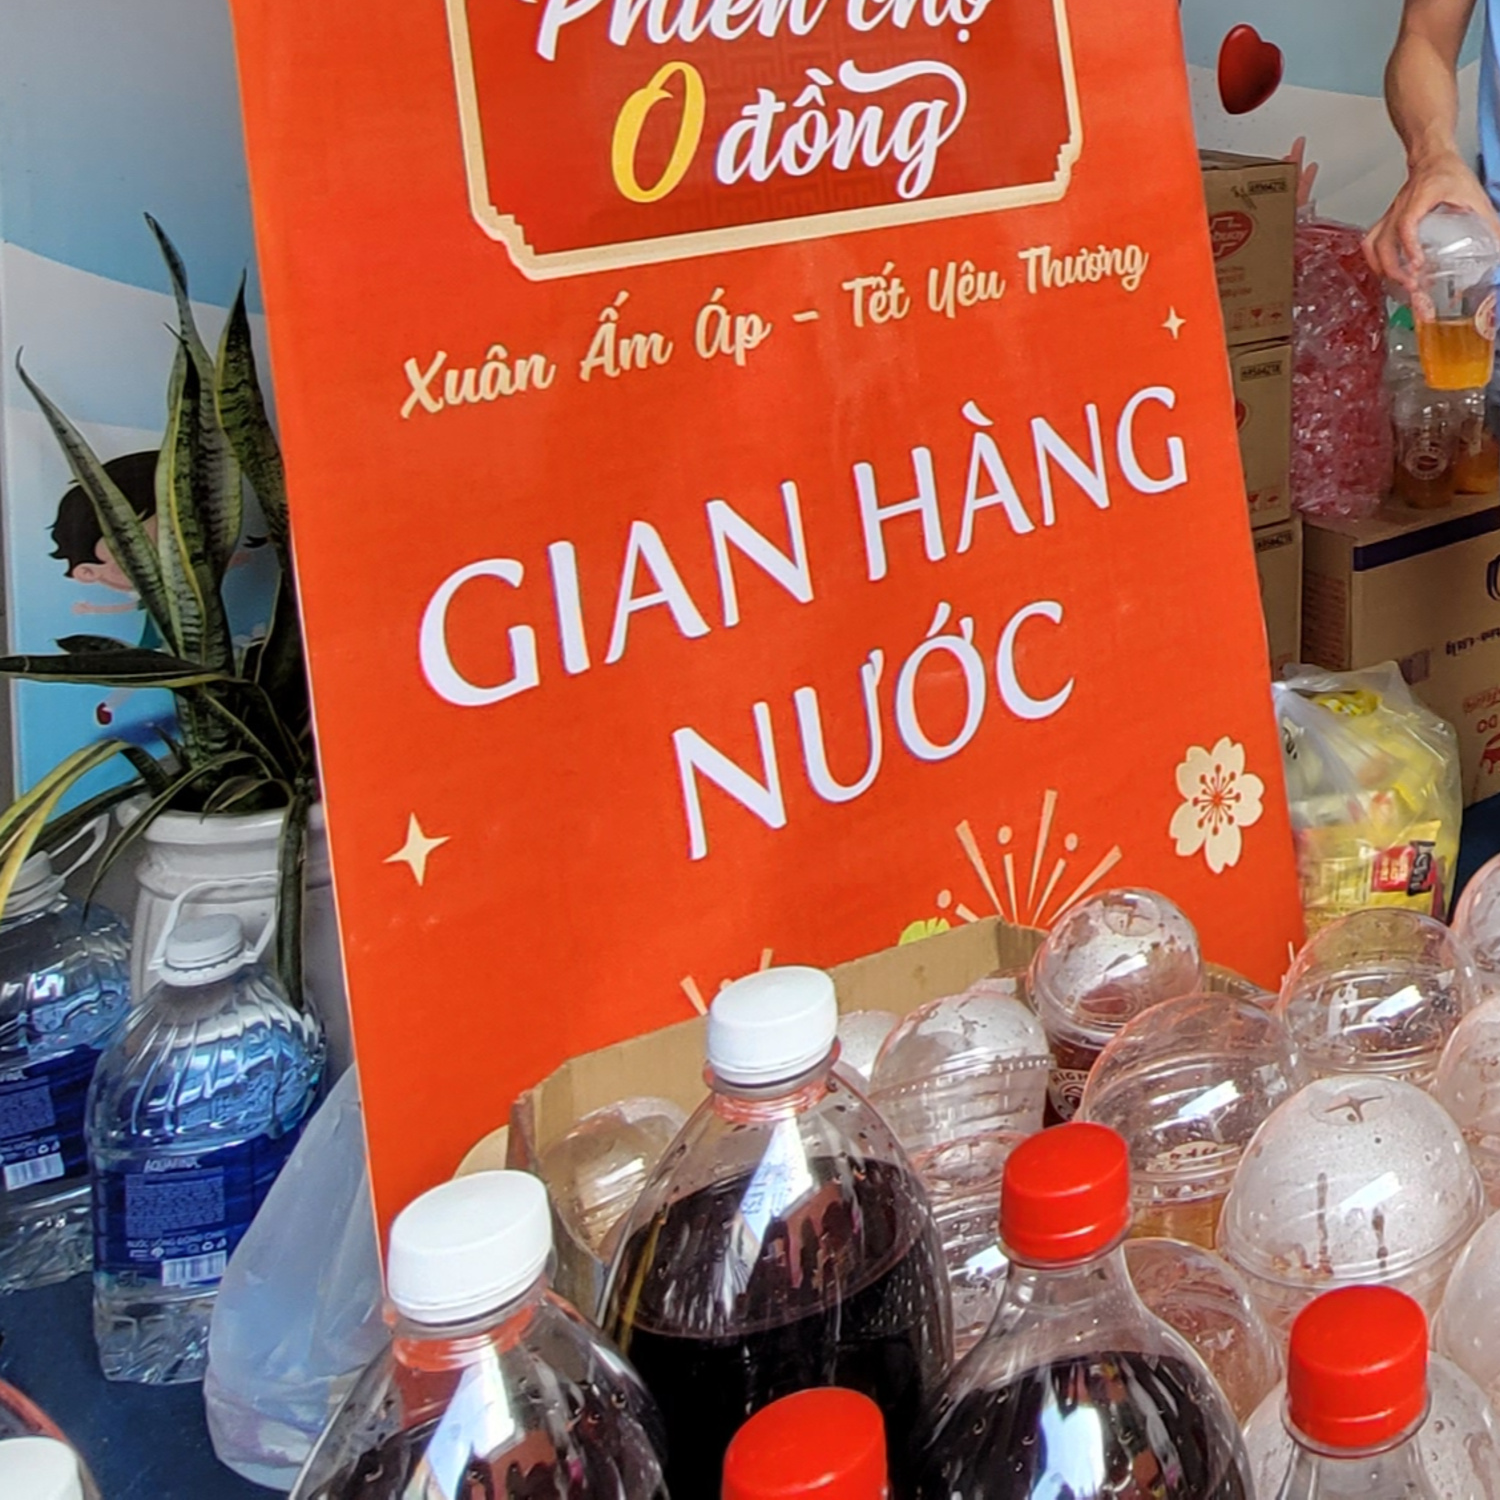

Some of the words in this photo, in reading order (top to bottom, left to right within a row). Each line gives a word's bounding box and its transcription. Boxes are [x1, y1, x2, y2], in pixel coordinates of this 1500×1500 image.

[714, 58, 967, 201] đồng
[400, 348, 557, 419] Xuân
[580, 291, 672, 381] Ấm
[694, 286, 773, 365] Áp
[793, 309, 820, 323] -
[842, 263, 910, 329] Tết
[928, 261, 1006, 319] Yêu
[1018, 243, 1149, 295] Thương
[418, 480, 814, 708] GIAN
[852, 386, 1189, 581] HÀNG
[670, 599, 1077, 861] NƯỚC
